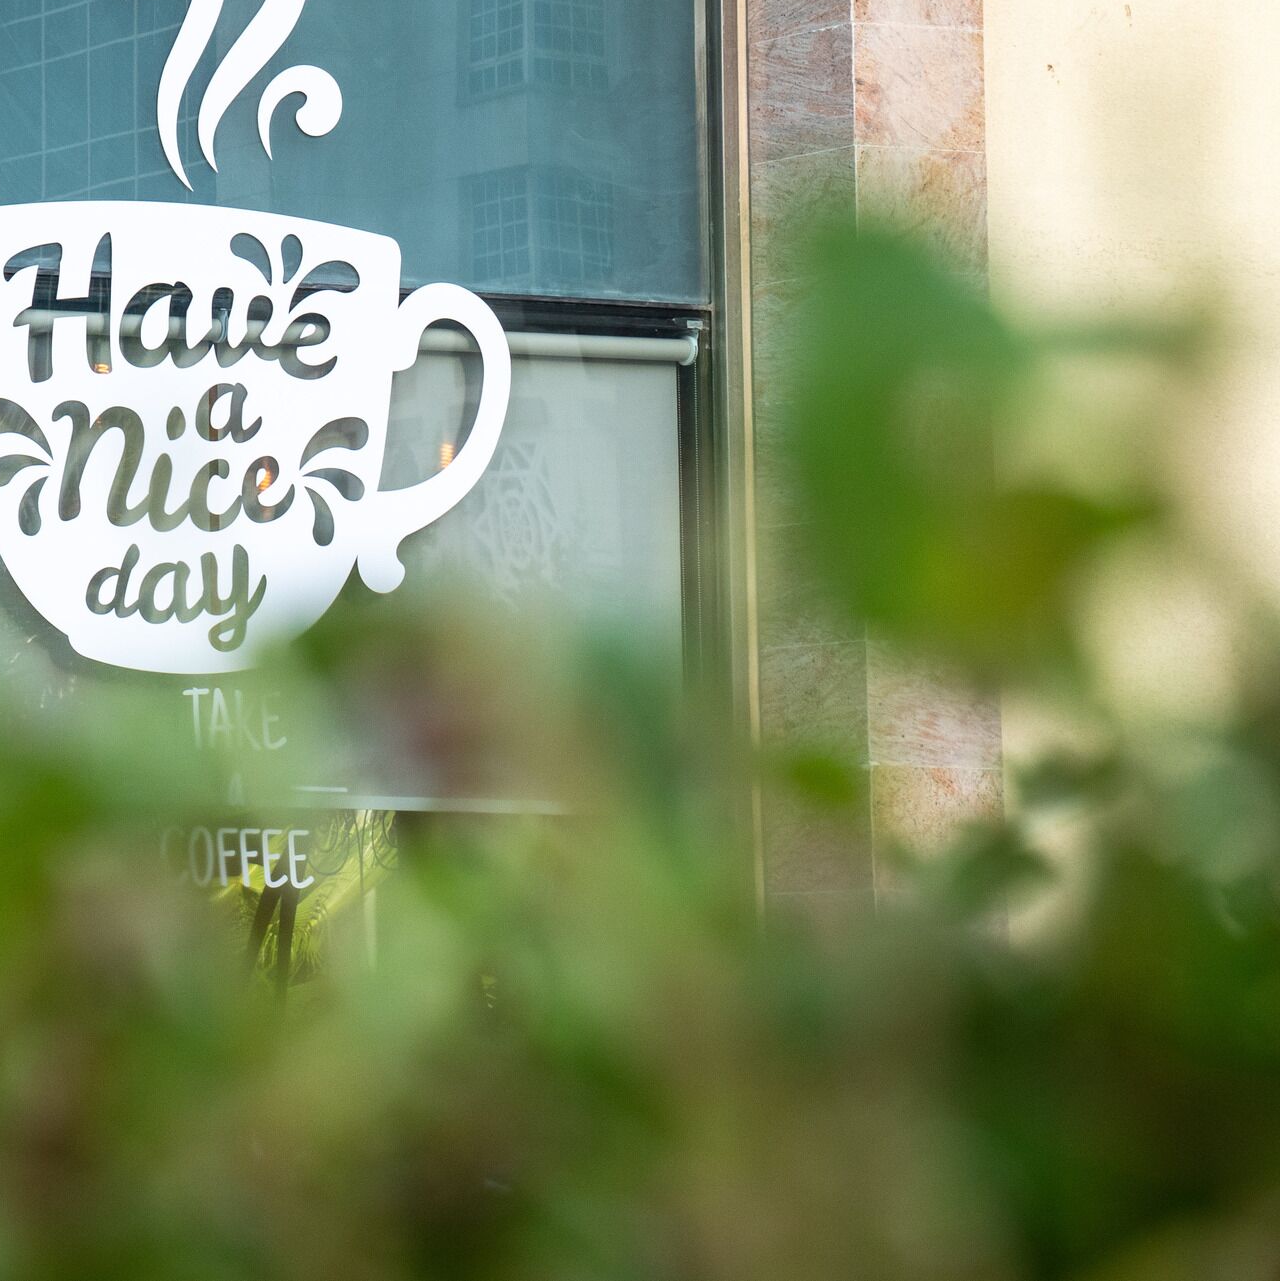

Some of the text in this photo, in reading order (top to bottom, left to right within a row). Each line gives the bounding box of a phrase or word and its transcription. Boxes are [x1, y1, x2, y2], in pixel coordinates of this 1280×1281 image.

[3, 231, 338, 384] Have
[51, 400, 296, 533] Nice
[195, 382, 263, 444] a
[85, 543, 268, 652] day
[182, 686, 288, 751] TAKE
